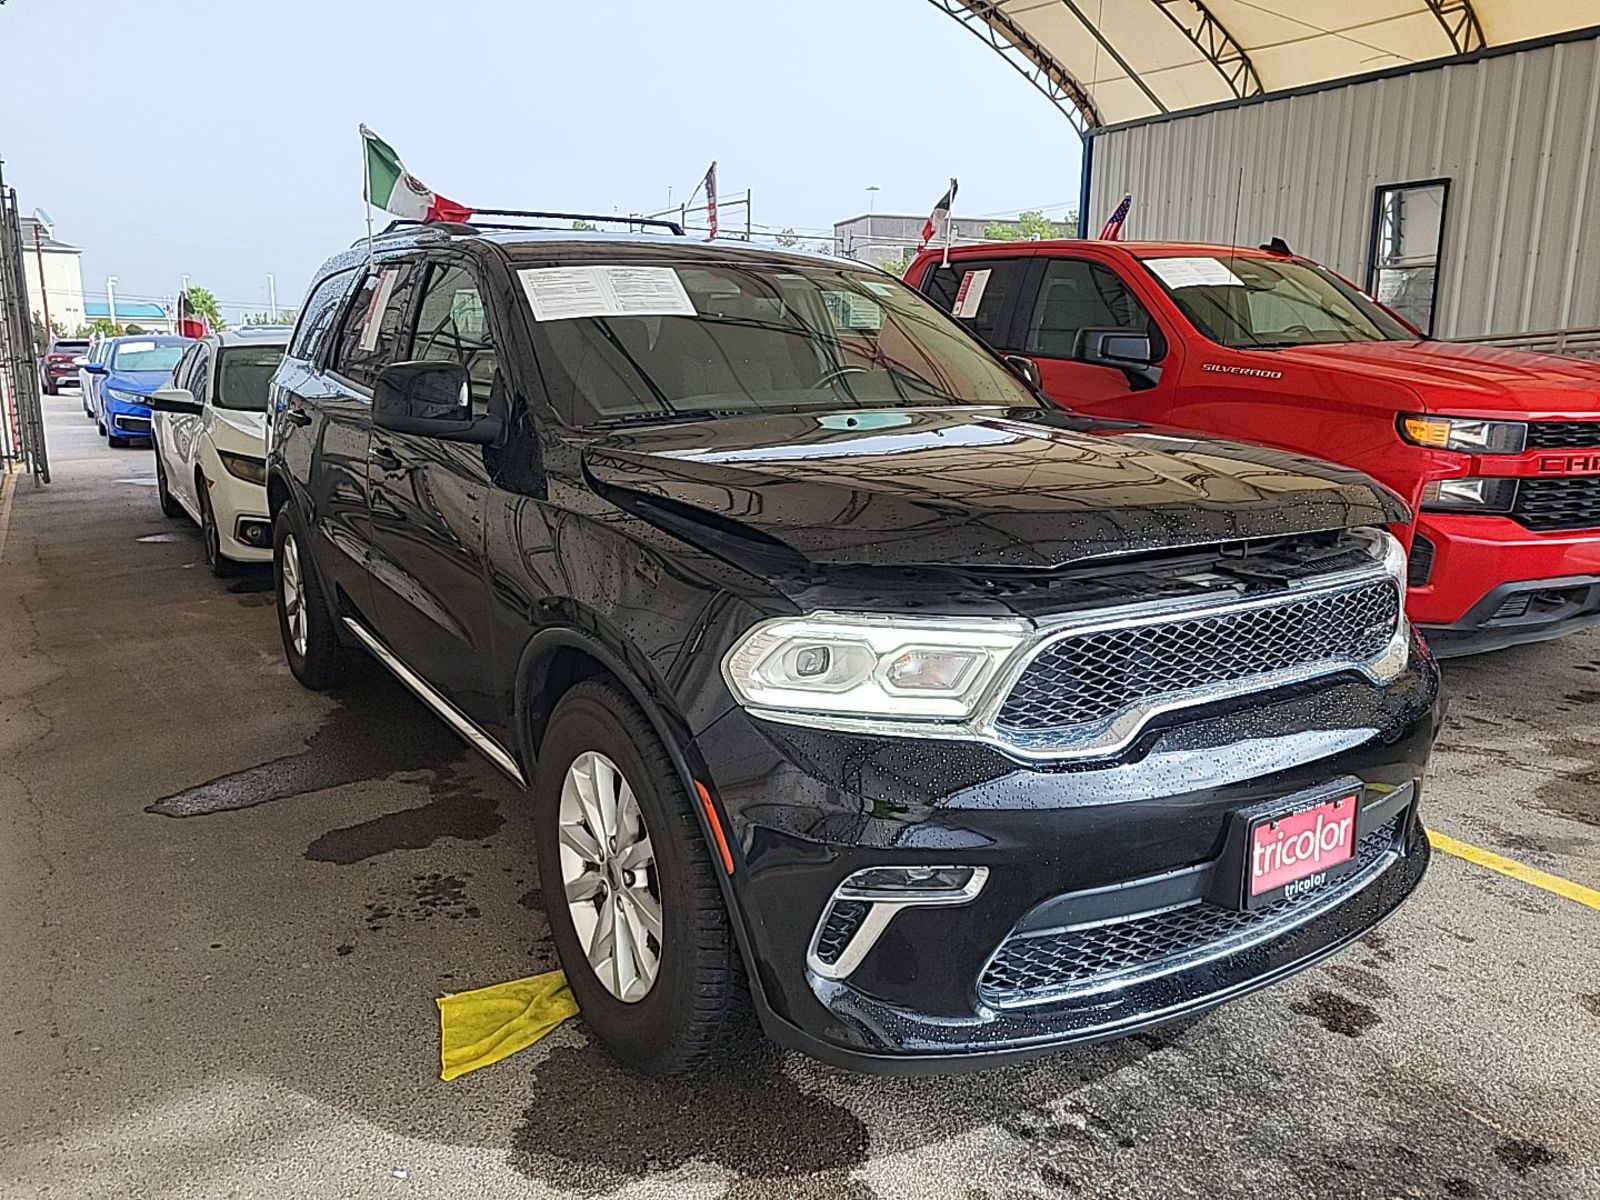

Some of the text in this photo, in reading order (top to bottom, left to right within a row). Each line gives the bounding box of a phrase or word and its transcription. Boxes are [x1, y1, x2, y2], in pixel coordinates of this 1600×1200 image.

[1202, 363, 1282, 379] SILVERADO
[1253, 816, 1352, 876] tricolor
[1284, 872, 1327, 897] tricolor
